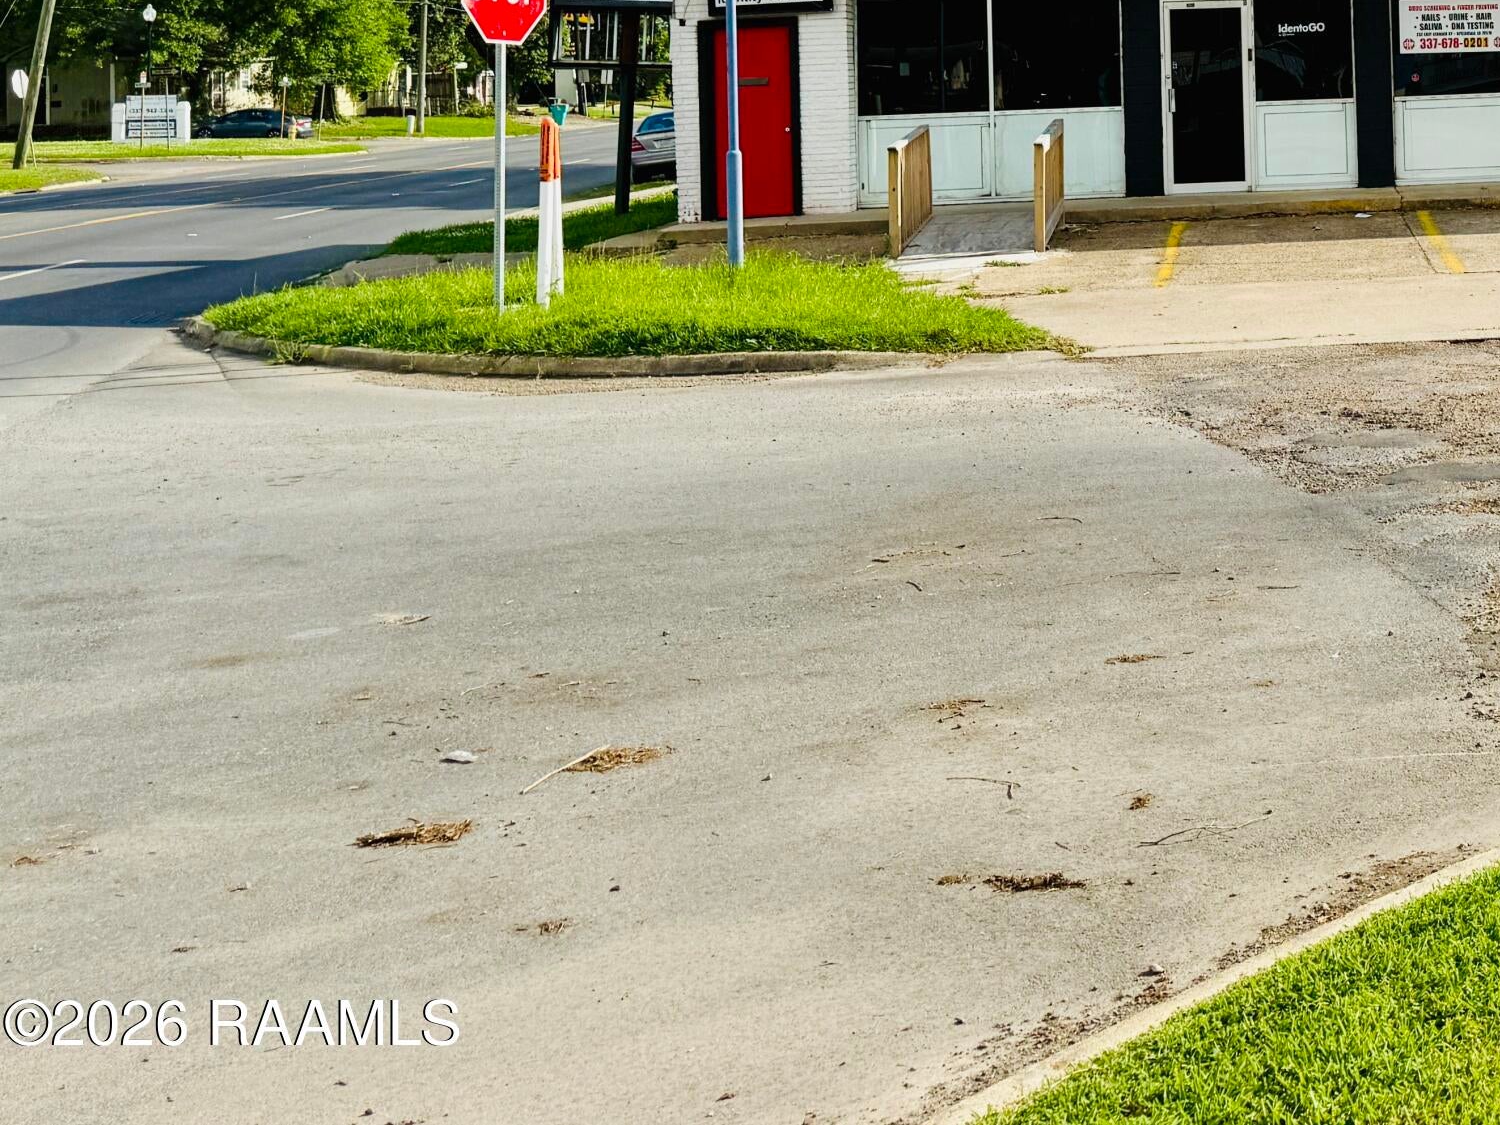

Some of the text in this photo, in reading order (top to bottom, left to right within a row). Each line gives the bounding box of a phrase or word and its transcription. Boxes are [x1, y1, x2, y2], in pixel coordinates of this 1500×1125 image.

[1421, 12, 1493, 22] NAILS URINE HAIR
[1278, 22, 1326, 33] IdentoGO
[1419, 21, 1495, 31] SALIVA DNA TESTING
[1420, 37, 1490, 49] 337-678-0201
